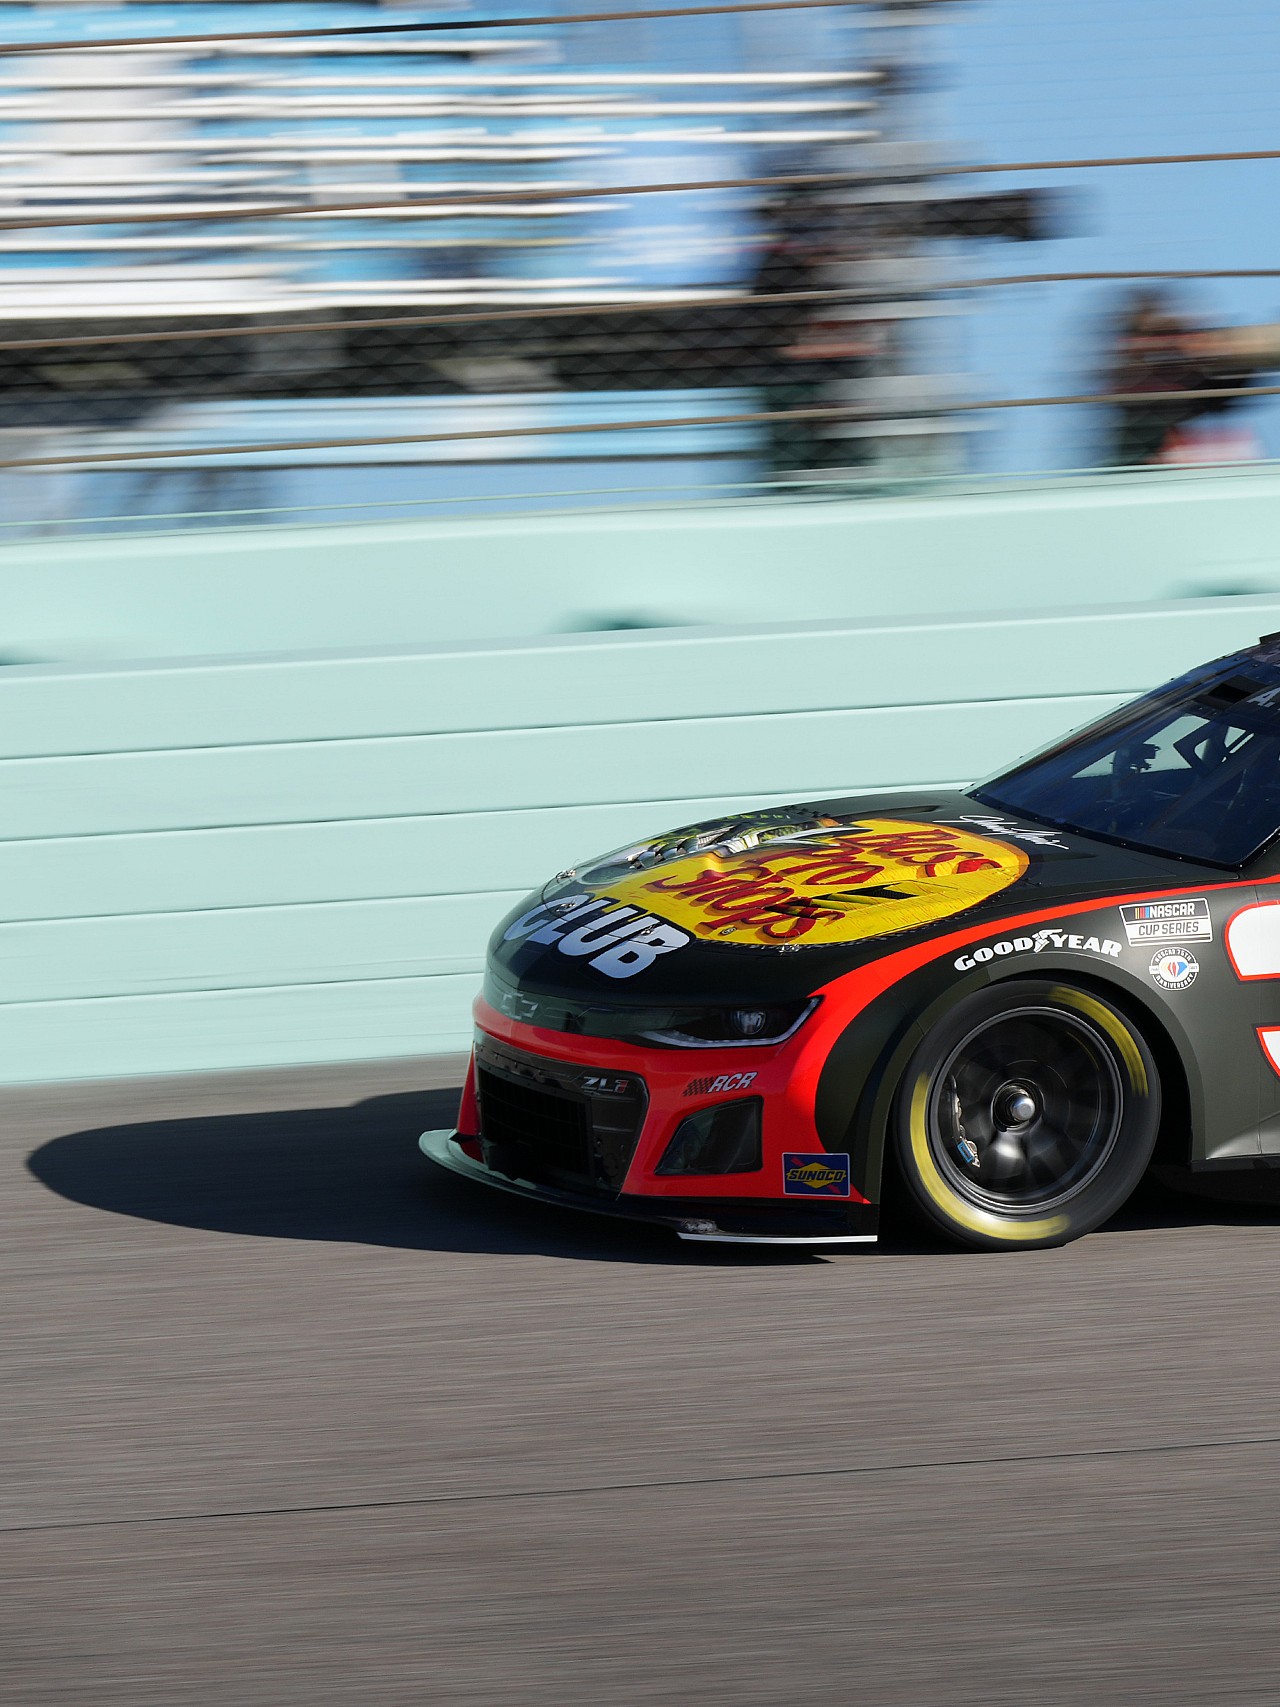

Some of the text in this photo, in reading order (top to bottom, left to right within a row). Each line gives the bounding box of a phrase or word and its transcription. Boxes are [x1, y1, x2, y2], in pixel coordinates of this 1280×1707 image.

[1150, 903, 1195, 918] NASCAR
[503, 894, 691, 979] CLUB
[1139, 921, 1200, 936] CUP SERIES
[954, 929, 1123, 971] GOODYEAR
[709, 1072, 758, 1092] RCR
[789, 1169, 845, 1182] SUNOCO
